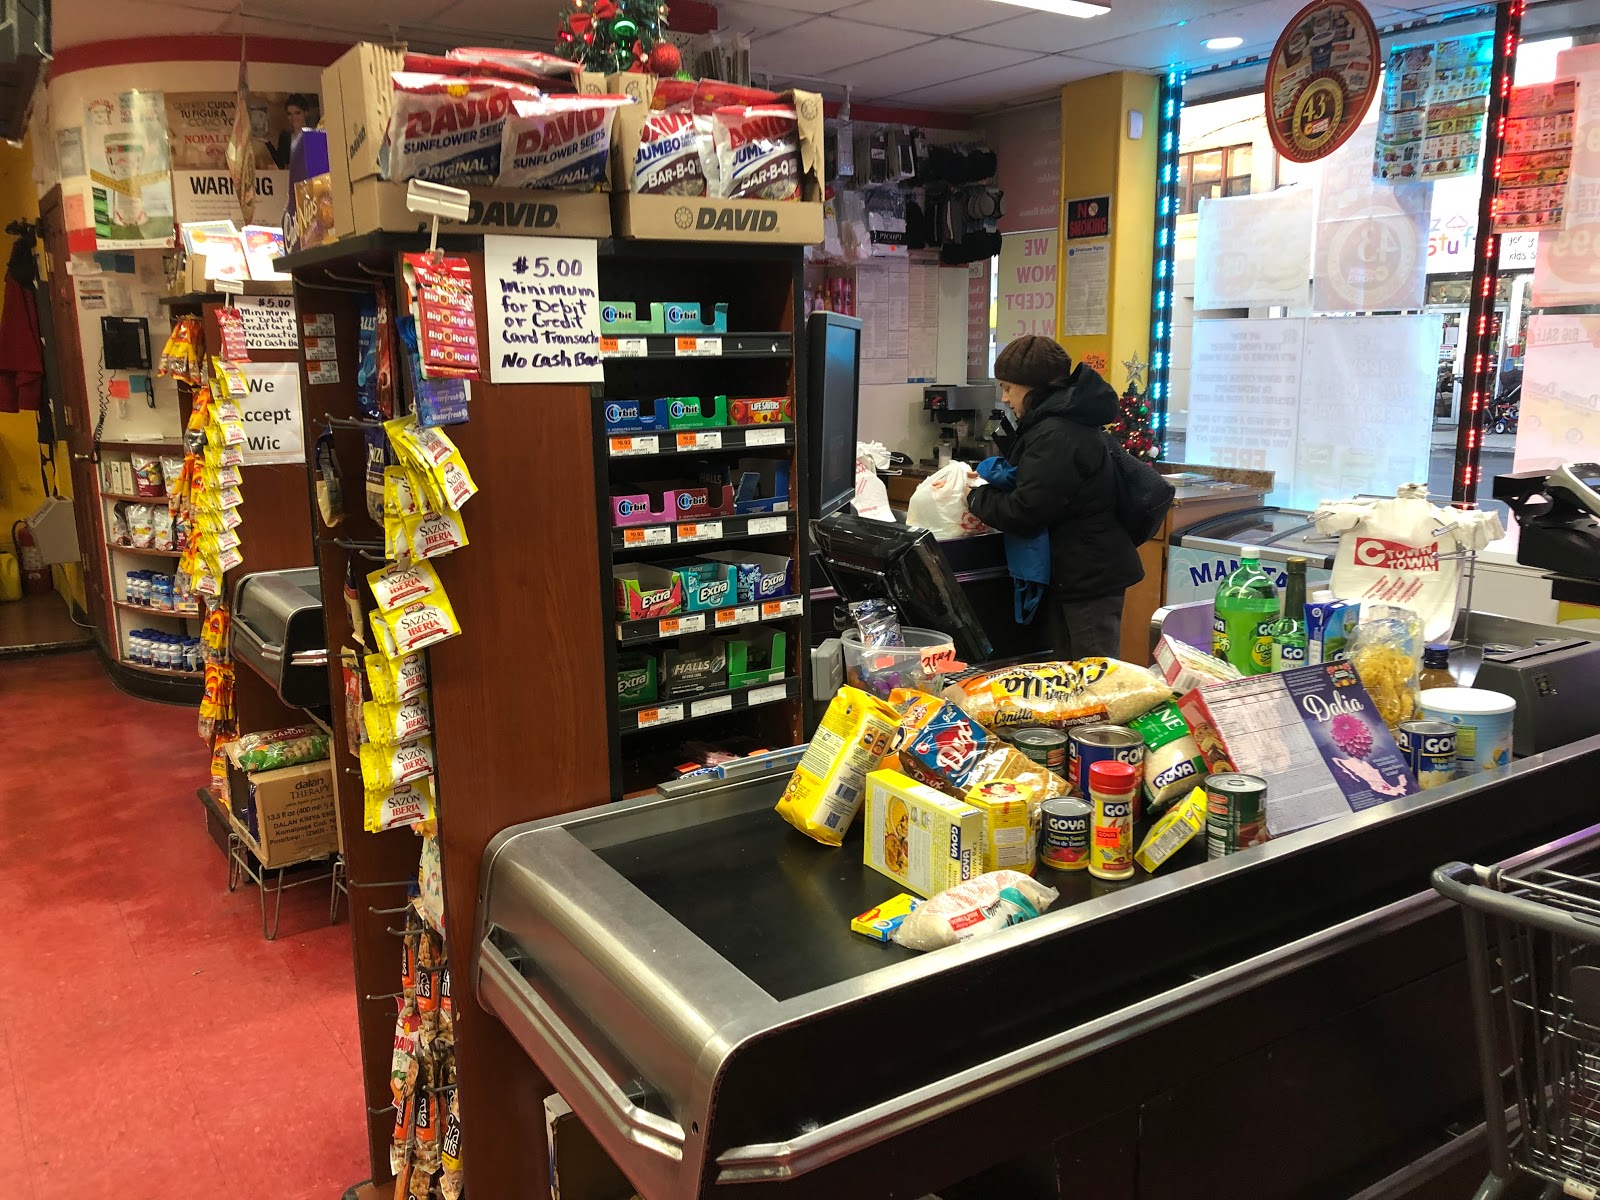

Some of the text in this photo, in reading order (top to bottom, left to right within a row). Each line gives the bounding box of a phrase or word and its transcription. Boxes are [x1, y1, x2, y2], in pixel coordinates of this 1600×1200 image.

[207, 101, 236, 109] CUIDA
[404, 91, 509, 140] DAVID
[515, 107, 606, 155] DAVID
[403, 130, 478, 155] SUNFLOWER
[512, 129, 606, 169] SUNFLOWER SEEDS
[635, 137, 681, 164] JUMBO
[414, 157, 489, 180] ORIGINAL
[695, 207, 778, 232] DAVID
[1069, 217, 1107, 236] SMOKING
[1427, 225, 1477, 257] Stuf
[499, 278, 595, 298] Minimum
[258, 298, 291, 308] $5.00
[501, 295, 587, 316] for Debit
[427, 311, 467, 325] Big Red
[504, 312, 583, 329] or Credit
[602, 305, 632, 324] Orbit
[667, 305, 699, 324] Orbit
[428, 329, 469, 343] Big Red
[502, 329, 538, 344] Card
[430, 349, 470, 362] Big Red
[501, 352, 528, 368] No
[531, 349, 572, 368] Cash
[247, 378, 275, 394] We
[241, 408, 292, 425] ccept
[605, 404, 638, 423] Orbit
[670, 401, 700, 419] Orbit
[247, 436, 281, 451] Wic
[618, 500, 648, 516] Orbit
[677, 493, 707, 510] Orbit
[419, 521, 452, 538] SAZÓN
[425, 531, 454, 545] IBERIA
[389, 576, 421, 595] IBERIA
[700, 581, 728, 601] Extra
[761, 572, 785, 591] Extra
[641, 590, 671, 609] Extra
[401, 608, 439, 630] SAZÓN
[407, 619, 441, 637] IBERIA
[1283, 648, 1304, 660] GO
[673, 660, 711, 676] HALLS
[617, 674, 647, 693] Extra
[400, 704, 427, 722] SAZÓN
[1302, 689, 1365, 723] Dalia
[396, 746, 426, 765] SAZÓN
[401, 757, 428, 772] IBERIA
[1117, 746, 1144, 765] GOY
[295, 777, 324, 790] dalan
[1155, 763, 1195, 788] GOYA
[289, 784, 331, 800] THERAPY
[387, 793, 420, 809] SAZÓN
[391, 804, 420, 817] IBERIA
[273, 819, 298, 830] DALAN
[1049, 818, 1086, 831] GOYA
[951, 826, 960, 859] GOYA
[962, 850, 971, 880] GOYA
